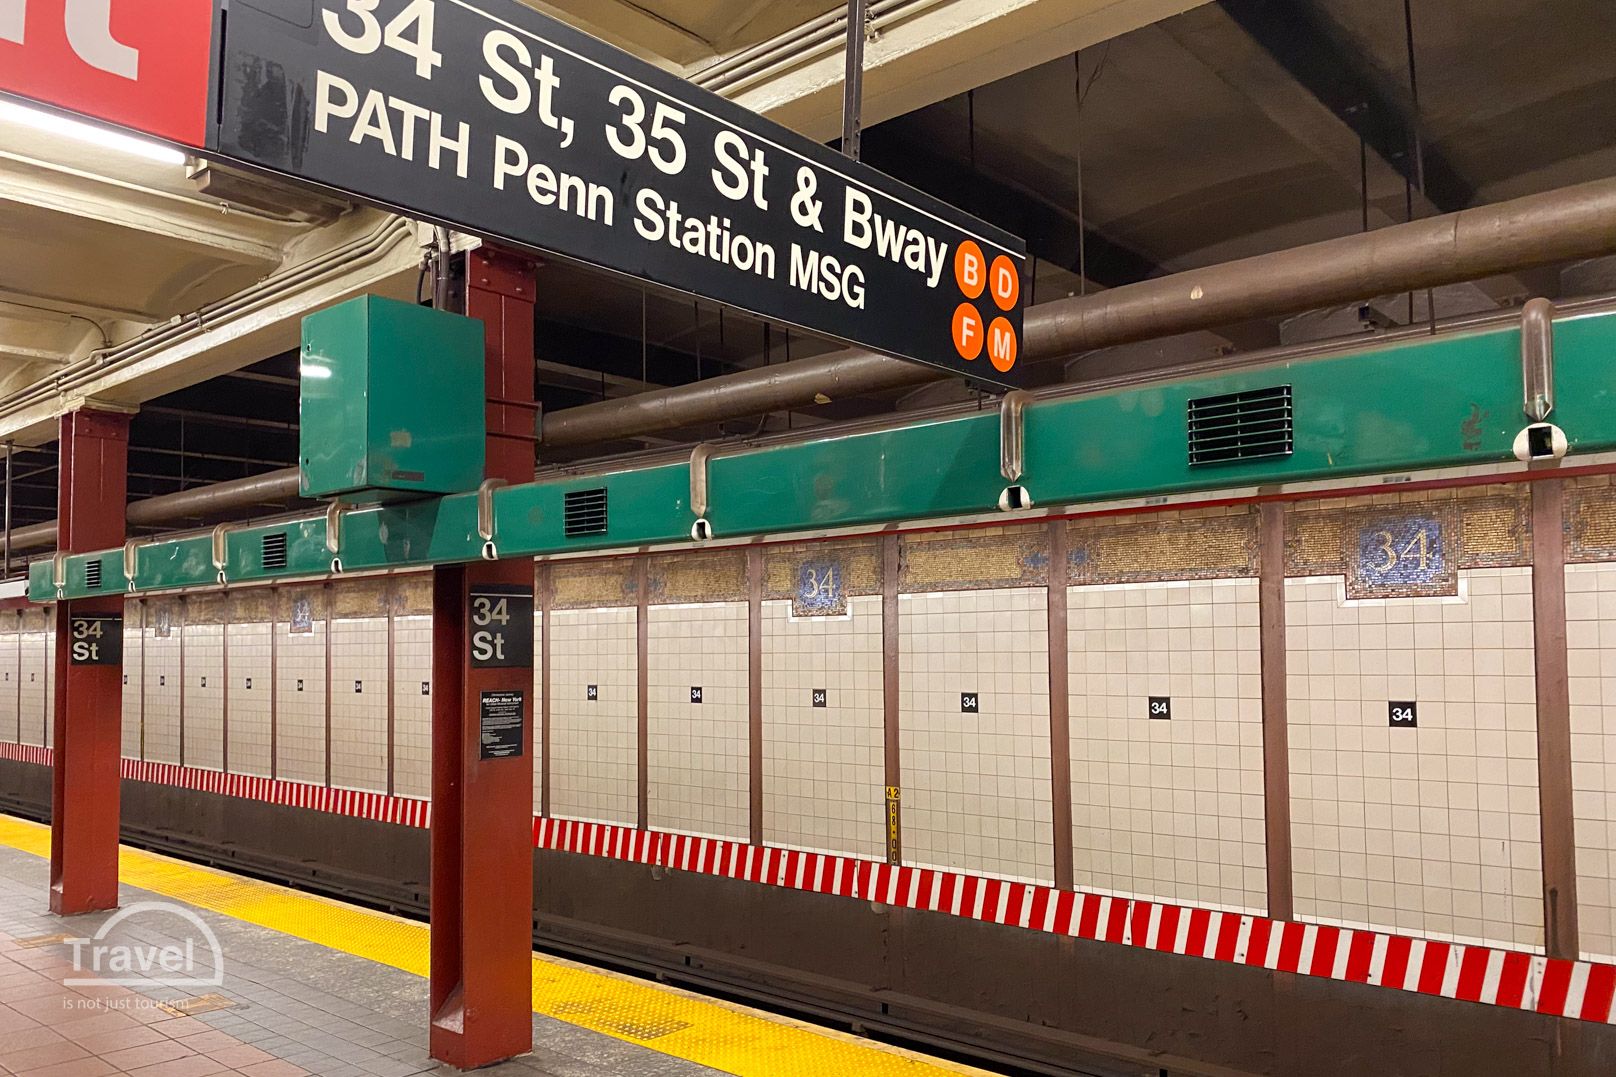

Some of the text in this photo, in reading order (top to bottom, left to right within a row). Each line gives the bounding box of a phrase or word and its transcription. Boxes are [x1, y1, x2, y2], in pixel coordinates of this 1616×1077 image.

[322, 0, 948, 289] 34 St, 35 St & Bway
[314, 69, 866, 311] PATH Penn Station MSG
[964, 252, 1013, 298] B D
[961, 315, 1011, 362] F M
[1367, 527, 1433, 573] 34
[806, 568, 836, 598] 34
[472, 597, 510, 626] 34
[73, 620, 103, 639] 34
[72, 641, 99, 661] St
[472, 630, 505, 661] St
[588, 688, 597, 697] 34
[692, 690, 701, 699] 34
[814, 693, 824, 703] 34
[963, 697, 976, 708] 34
[1151, 702, 1167, 714] 34
[1392, 708, 1413, 722] 34
